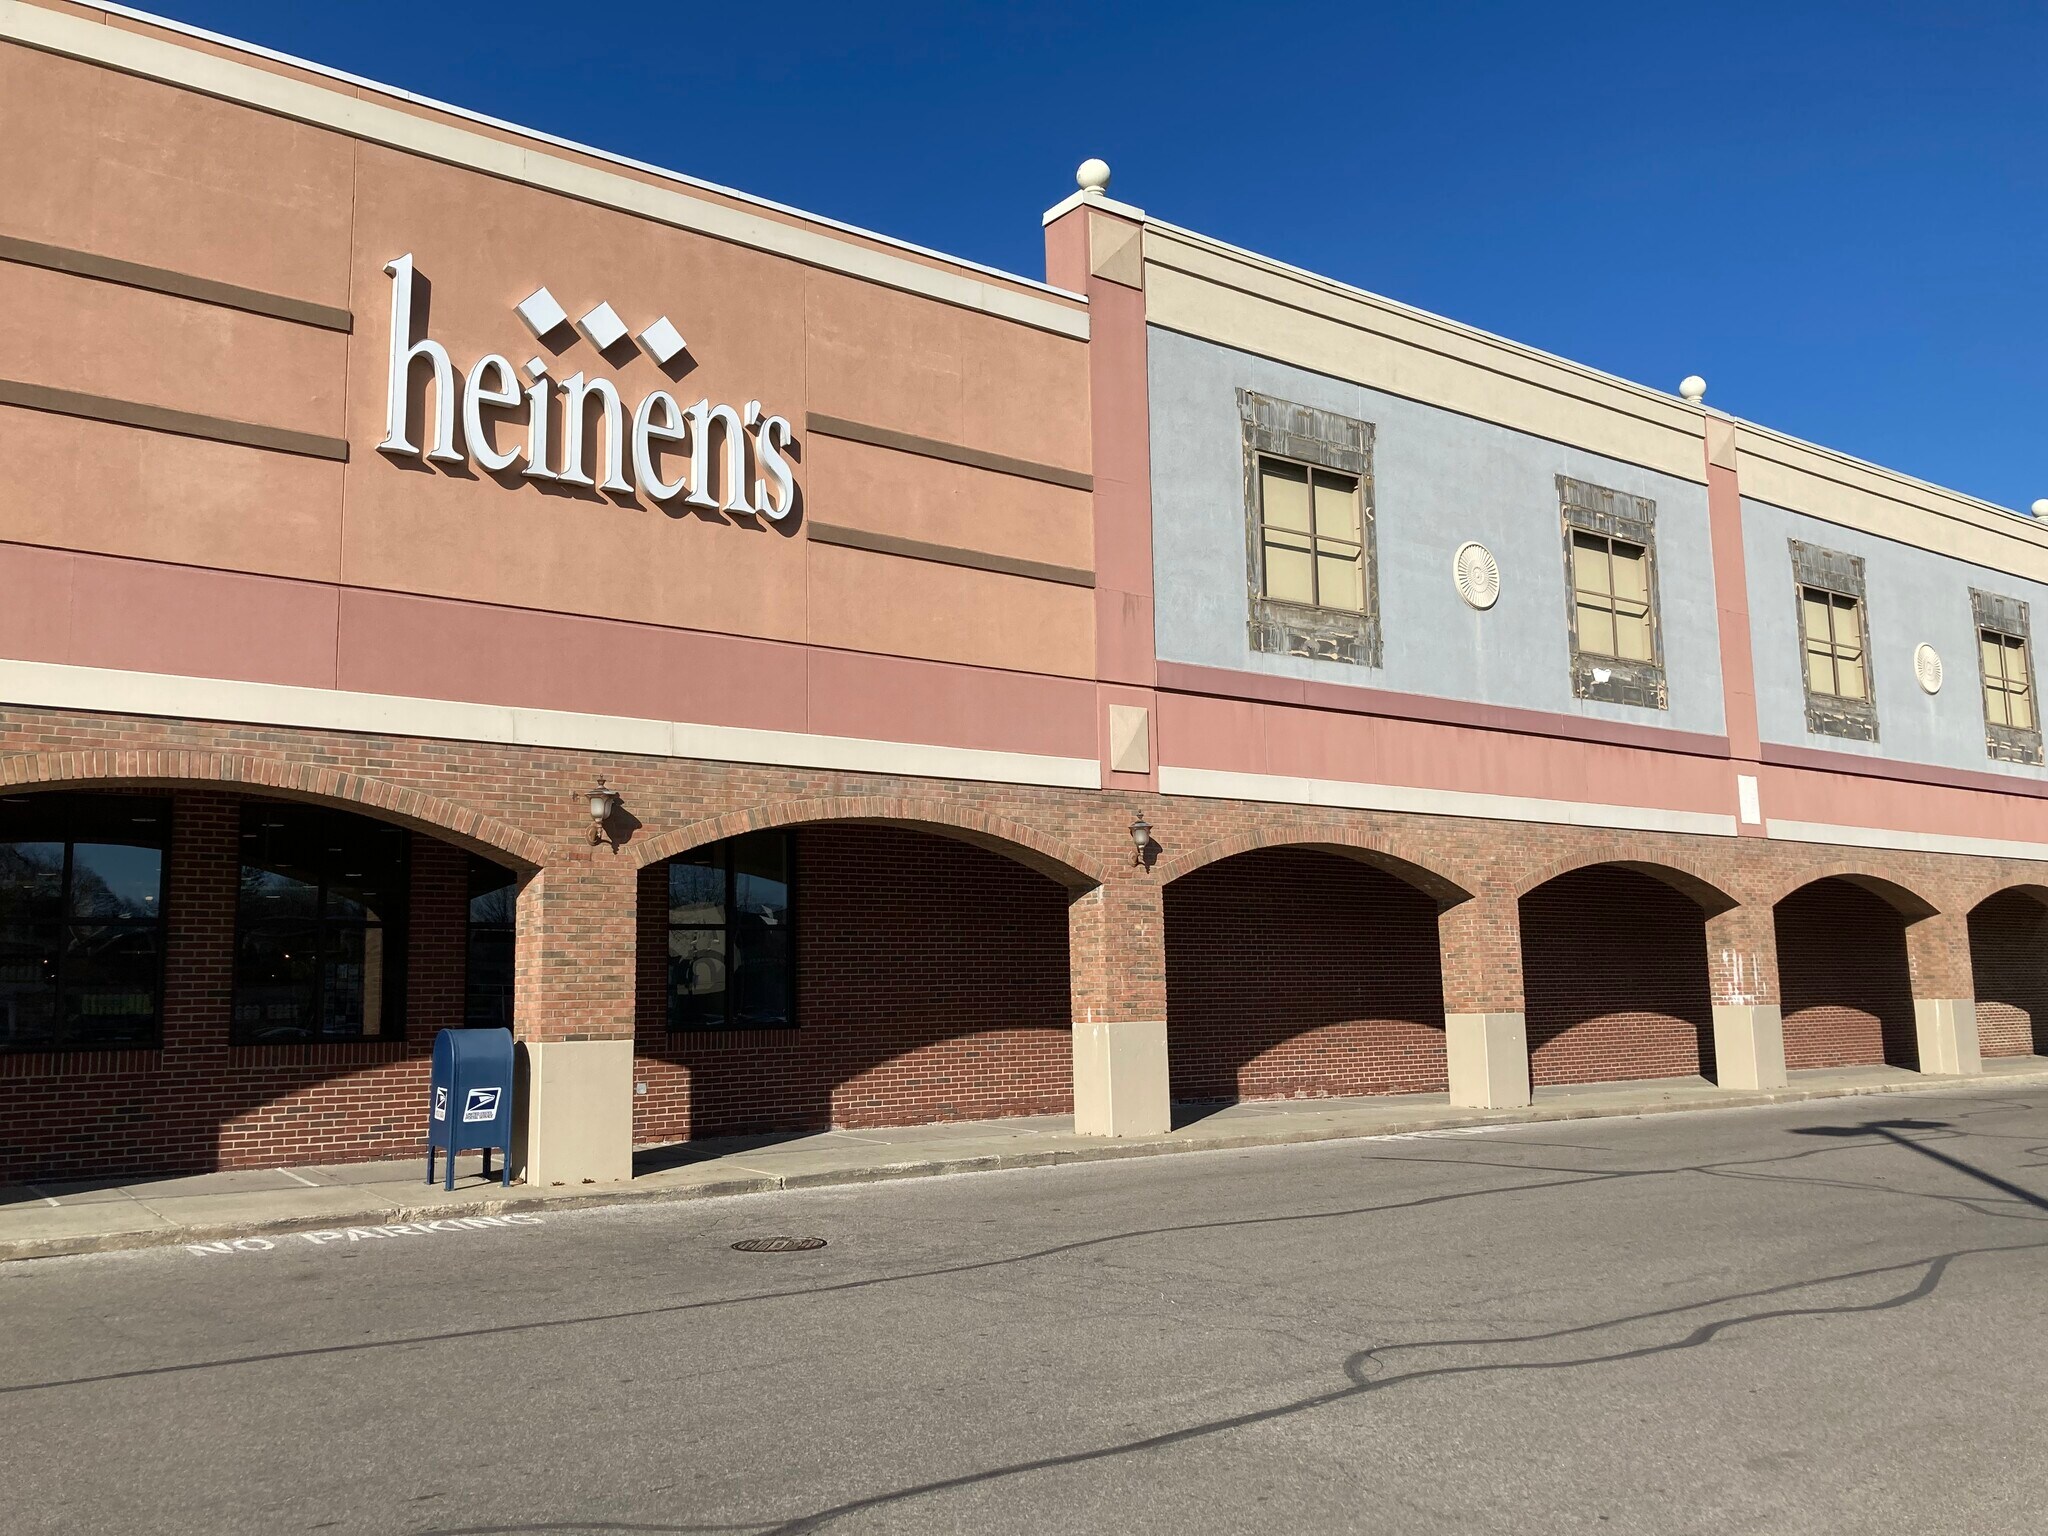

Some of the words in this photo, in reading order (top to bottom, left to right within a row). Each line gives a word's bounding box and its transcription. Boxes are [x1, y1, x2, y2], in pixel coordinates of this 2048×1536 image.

[375, 252, 794, 522] heinen's
[184, 1239, 275, 1257] NO
[300, 1214, 544, 1245] PARKING
